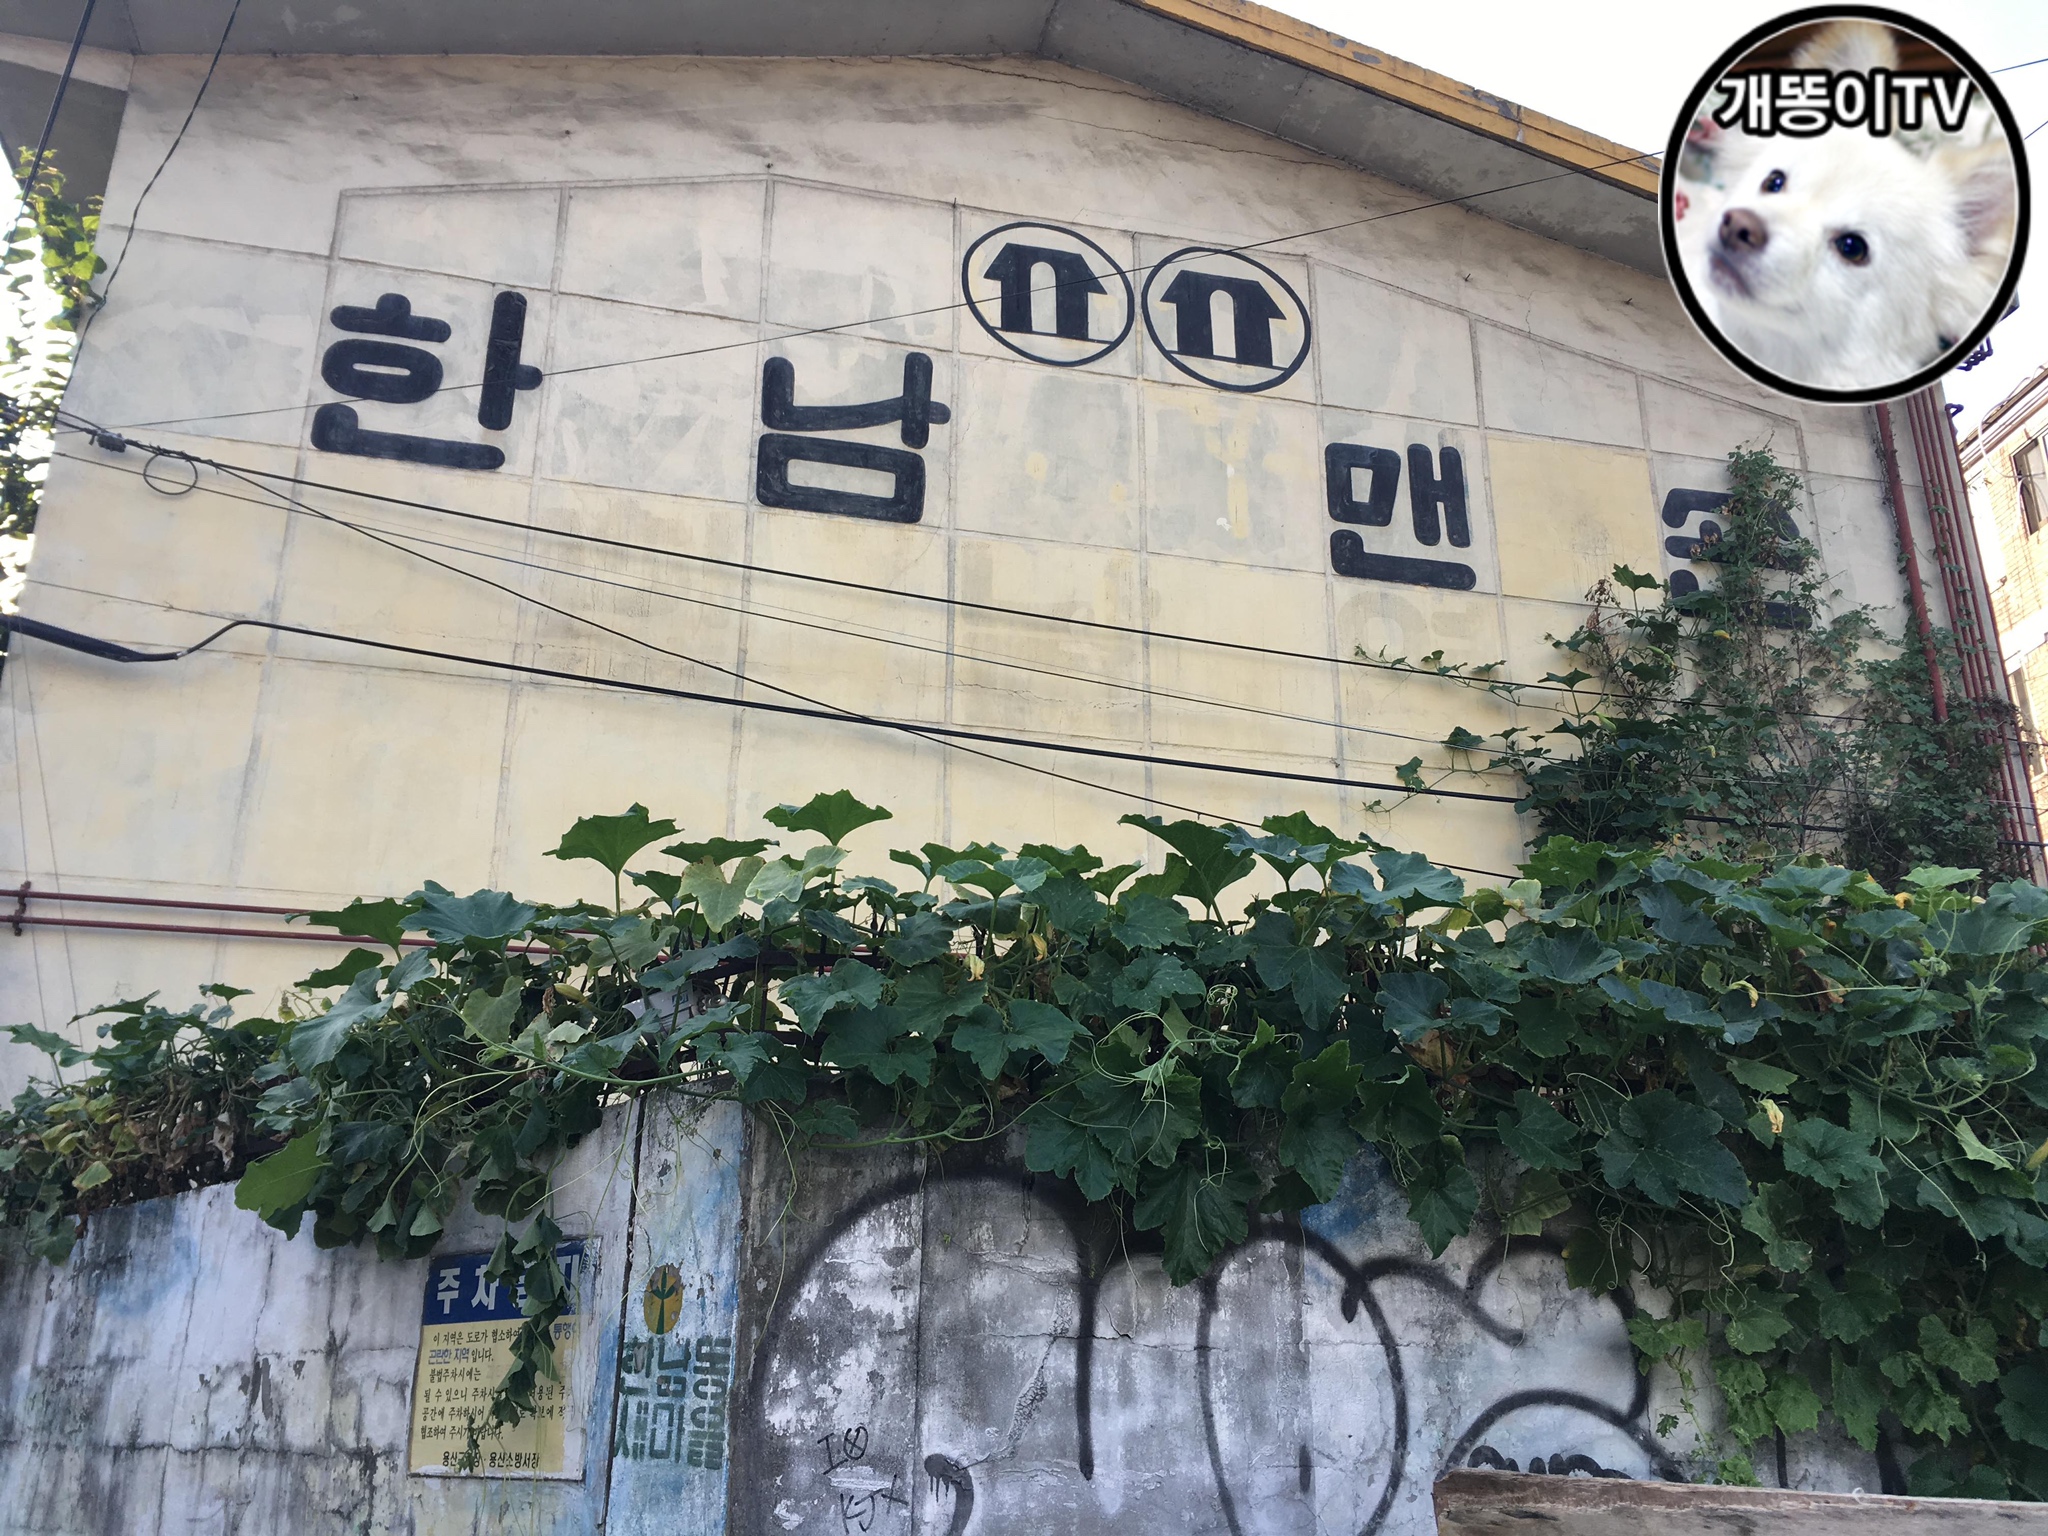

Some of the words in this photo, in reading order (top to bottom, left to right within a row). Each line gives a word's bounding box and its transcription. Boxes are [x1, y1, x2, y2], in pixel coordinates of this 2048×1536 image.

[436, 1254, 579, 1315] 주차지
[433, 1332, 440, 1346] 이
[443, 1331, 464, 1345] 지역은
[466, 1329, 488, 1343] 도로가
[428, 1348, 452, 1364] 곤란한
[453, 1347, 470, 1364] 지역
[429, 1367, 481, 1383] 불법주차시에는
[435, 1388, 442, 1402] 수
[445, 1387, 468, 1402] 있으니
[422, 1406, 445, 1421] 공간에
[448, 1406, 484, 1421] 주차하시어
[421, 1425, 447, 1440] 협조하여
[489, 1451, 540, 1468] 용산소방서장
